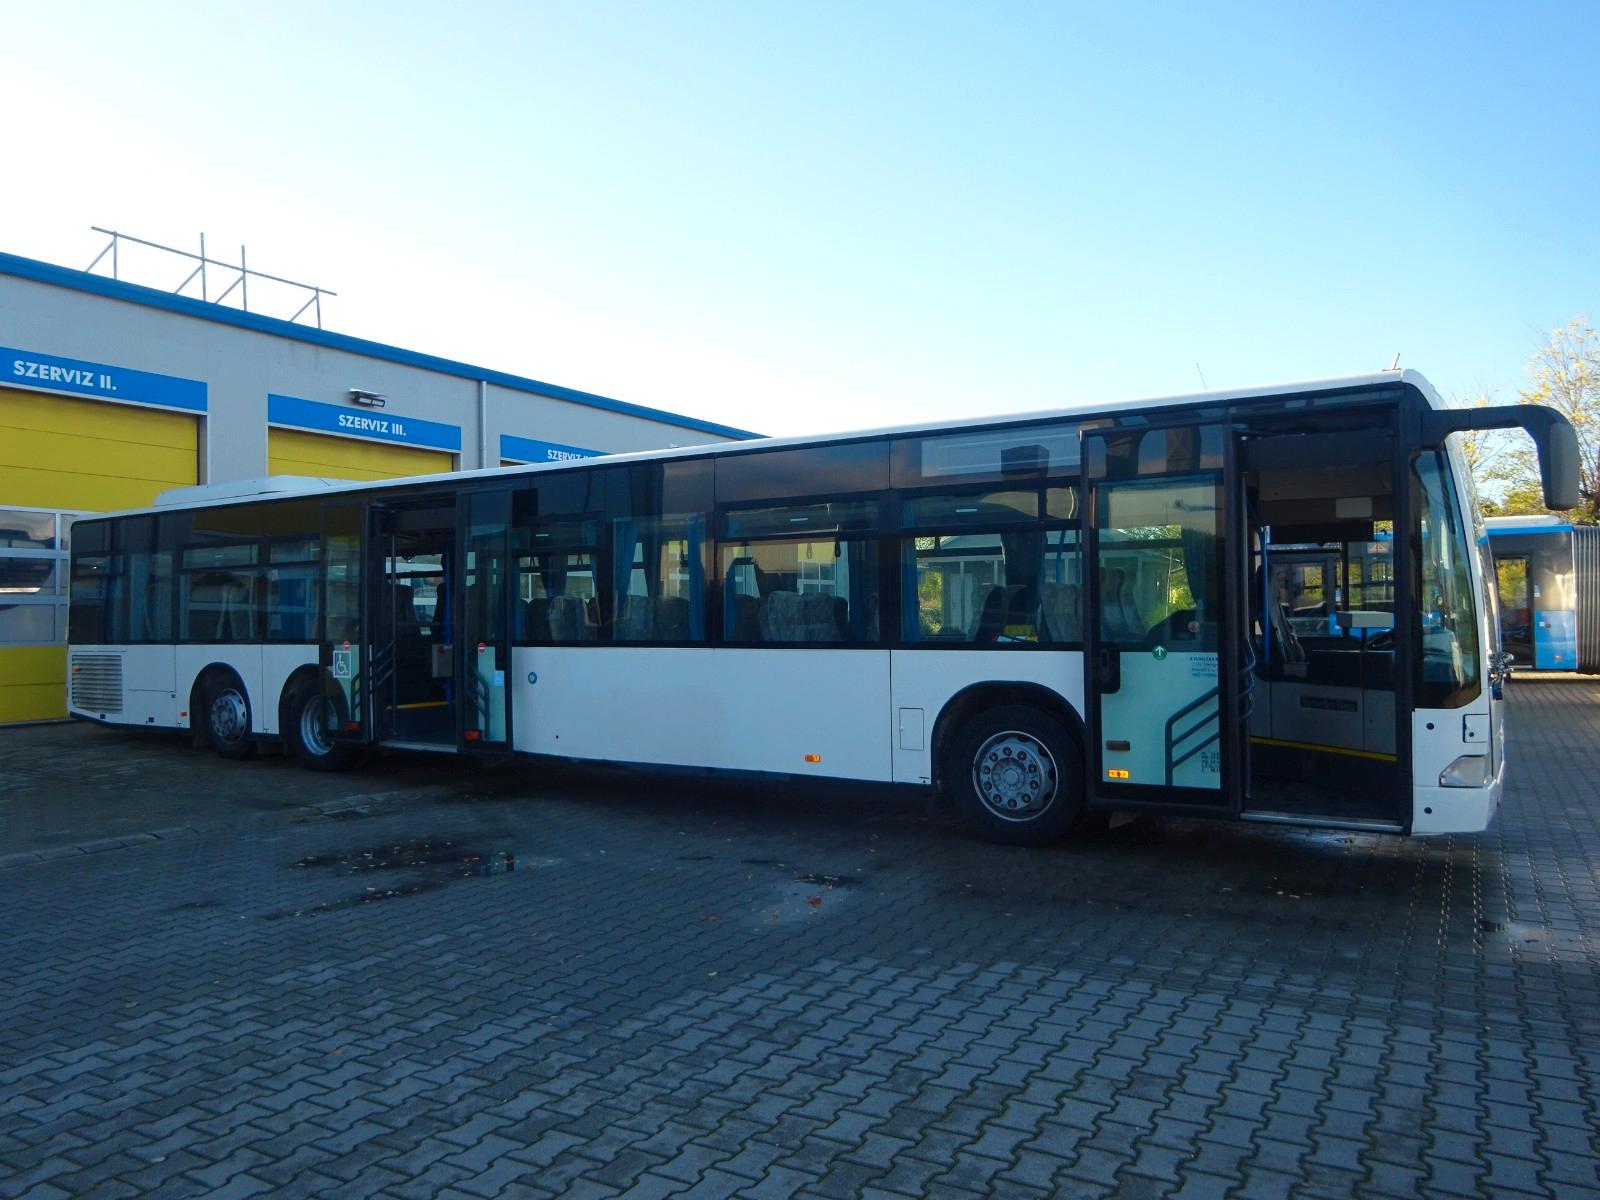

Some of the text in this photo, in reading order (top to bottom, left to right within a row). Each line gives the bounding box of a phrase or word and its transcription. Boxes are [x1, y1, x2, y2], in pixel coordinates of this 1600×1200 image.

[14, 360, 117, 391] SZERVIZ II.
[338, 415, 407, 437] SZERVIZ III.
